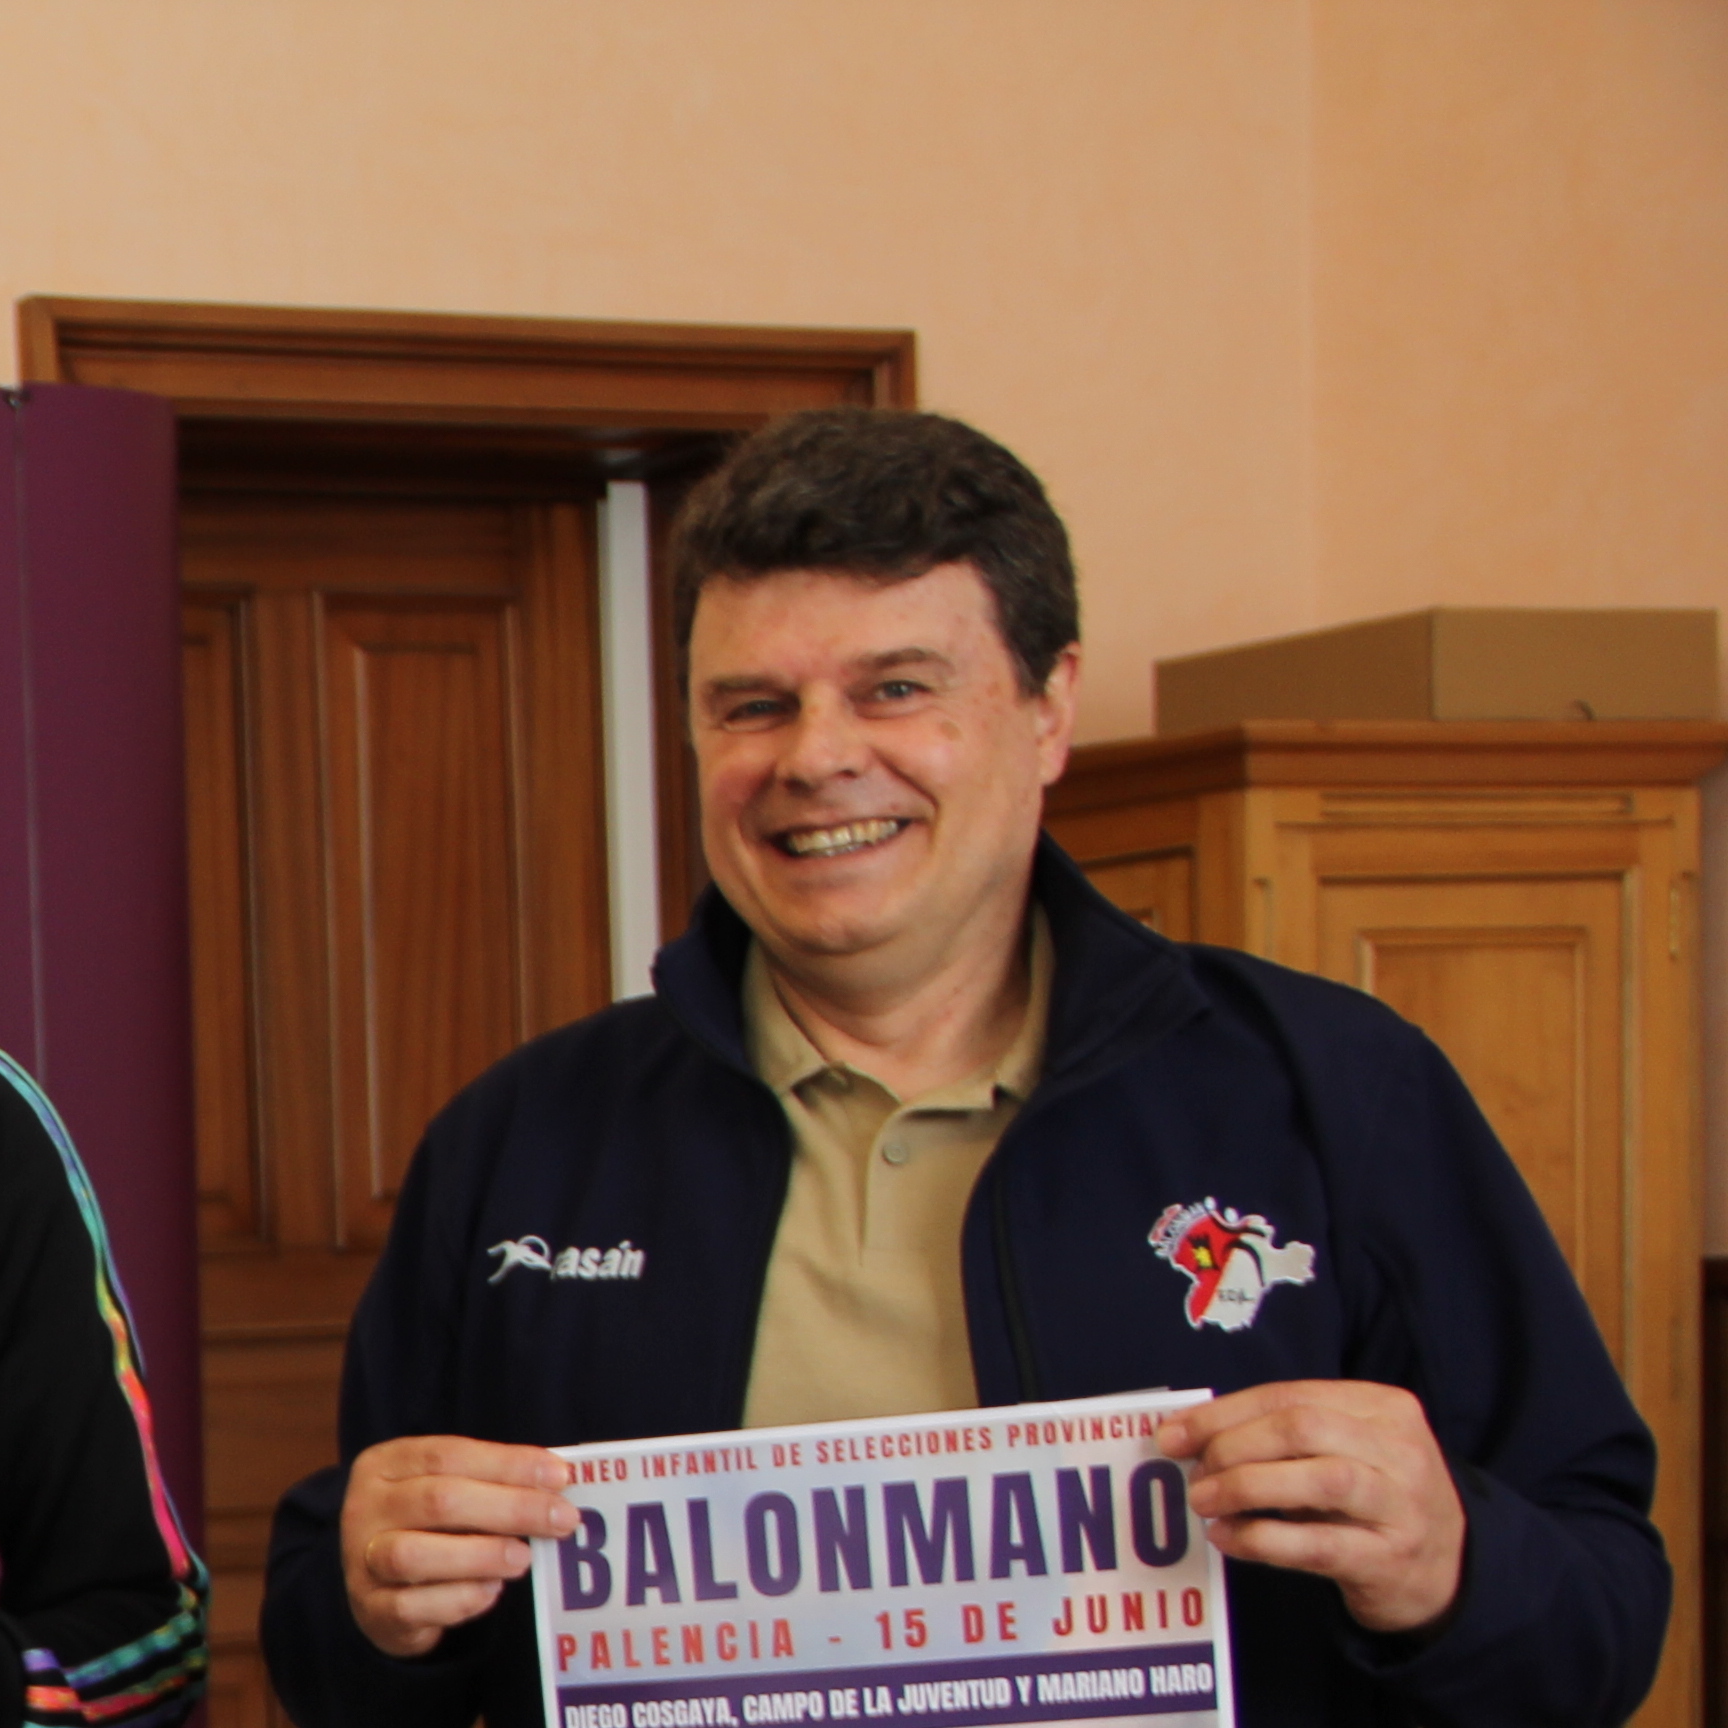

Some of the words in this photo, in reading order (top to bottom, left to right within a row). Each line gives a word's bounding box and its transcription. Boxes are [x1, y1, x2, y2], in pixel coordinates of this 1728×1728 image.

[567, 1458, 627, 1484] RNEO
[642, 1448, 758, 1479] INFANTIL
[771, 1443, 802, 1468] DE
[816, 1426, 993, 1464] SELECCIONES
[1007, 1411, 1164, 1448] PROVINCIA
[556, 1458, 1189, 1611] BALONMANO
[556, 1618, 795, 1672] PALENCIA
[875, 1608, 928, 1650] 15
[962, 1602, 1018, 1644] DE
[1052, 1586, 1204, 1637] JUNIO
[743, 1691, 820, 1724] CAMPO
[828, 1688, 860, 1718] DE
[862, 1685, 892, 1715] LA
[897, 1676, 1012, 1716] JUVENTUD
[1015, 1676, 1032, 1707] Y
[1036, 1667, 1145, 1704] MARIANO
[1149, 1663, 1213, 1696] HARO
